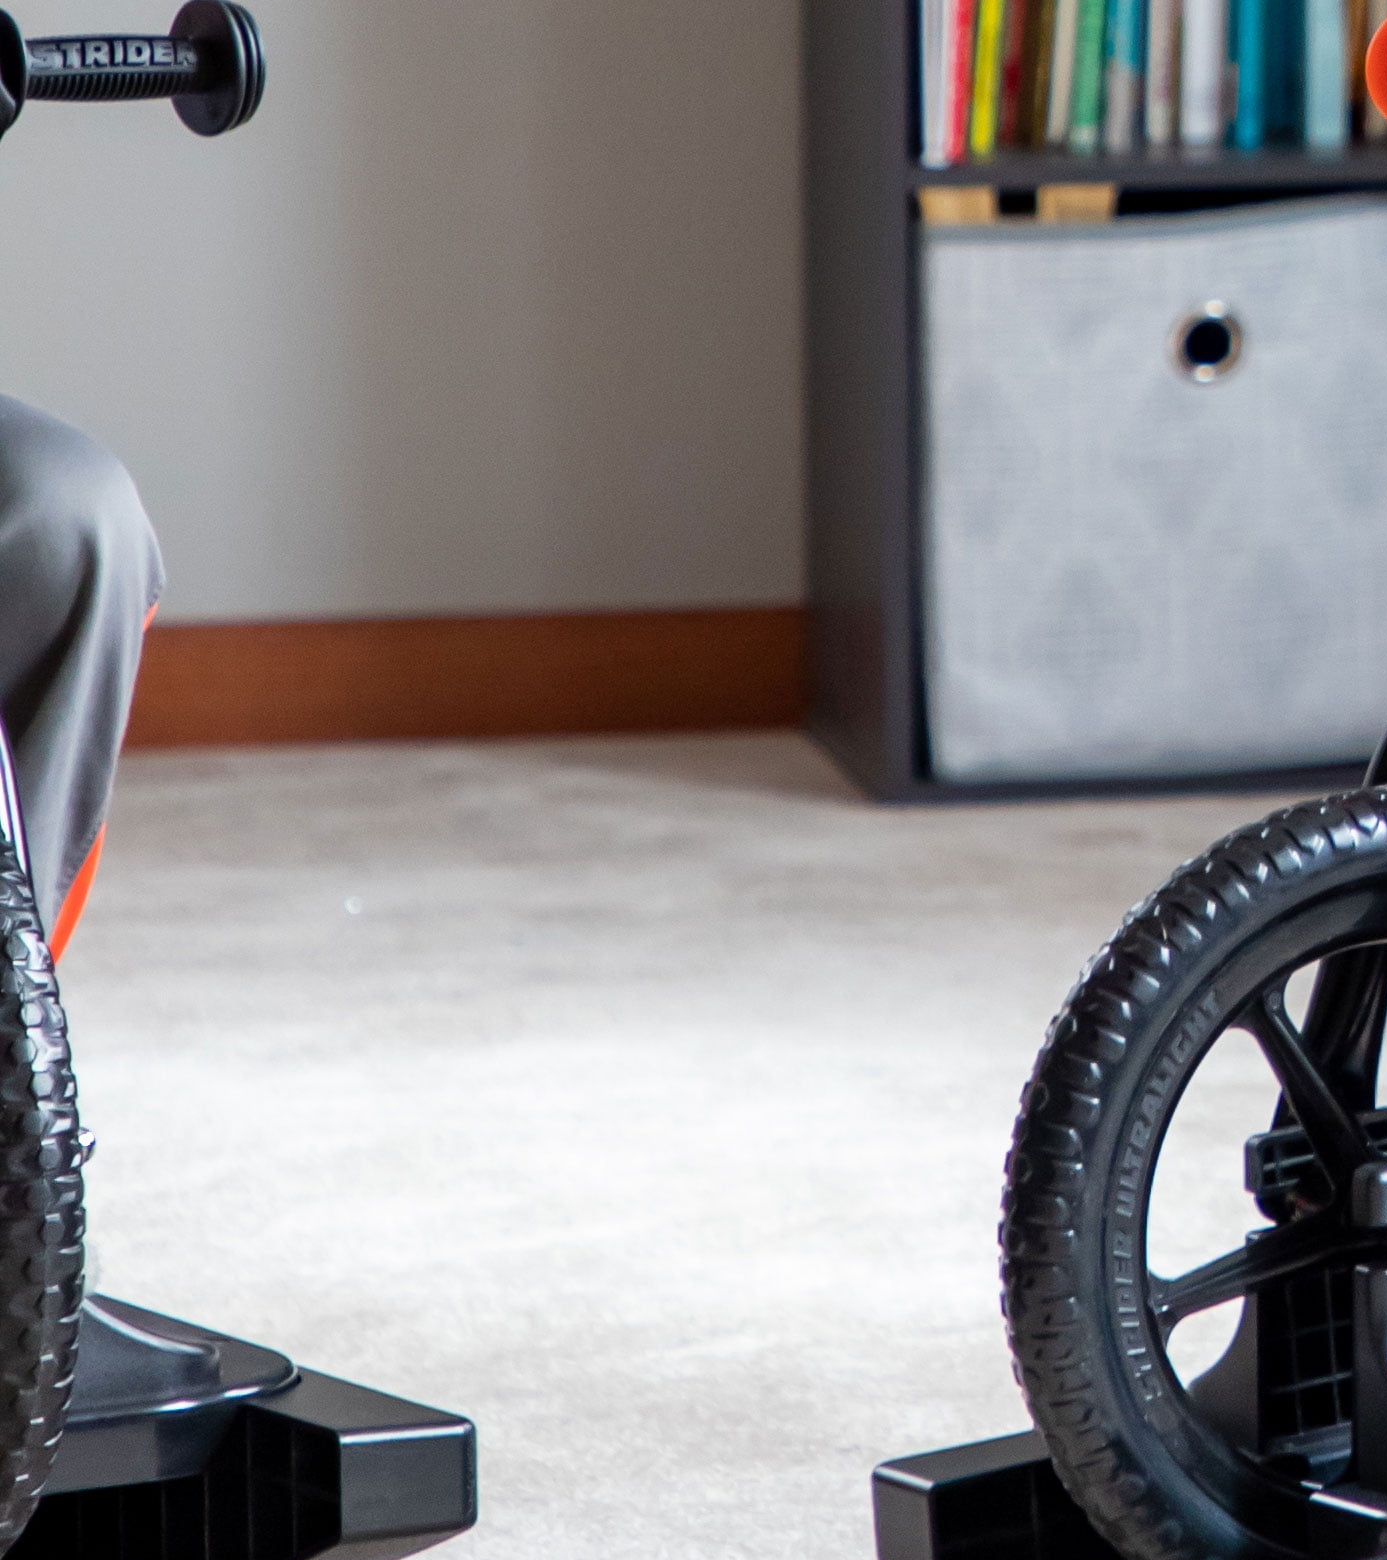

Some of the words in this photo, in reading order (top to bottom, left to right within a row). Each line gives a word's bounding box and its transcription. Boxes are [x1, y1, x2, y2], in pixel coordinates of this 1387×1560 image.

[29, 40, 197, 70] STRIDER
[1114, 990, 1220, 1219] ULTRALIGHT
[1112, 1230, 1163, 1403] STRIDER
